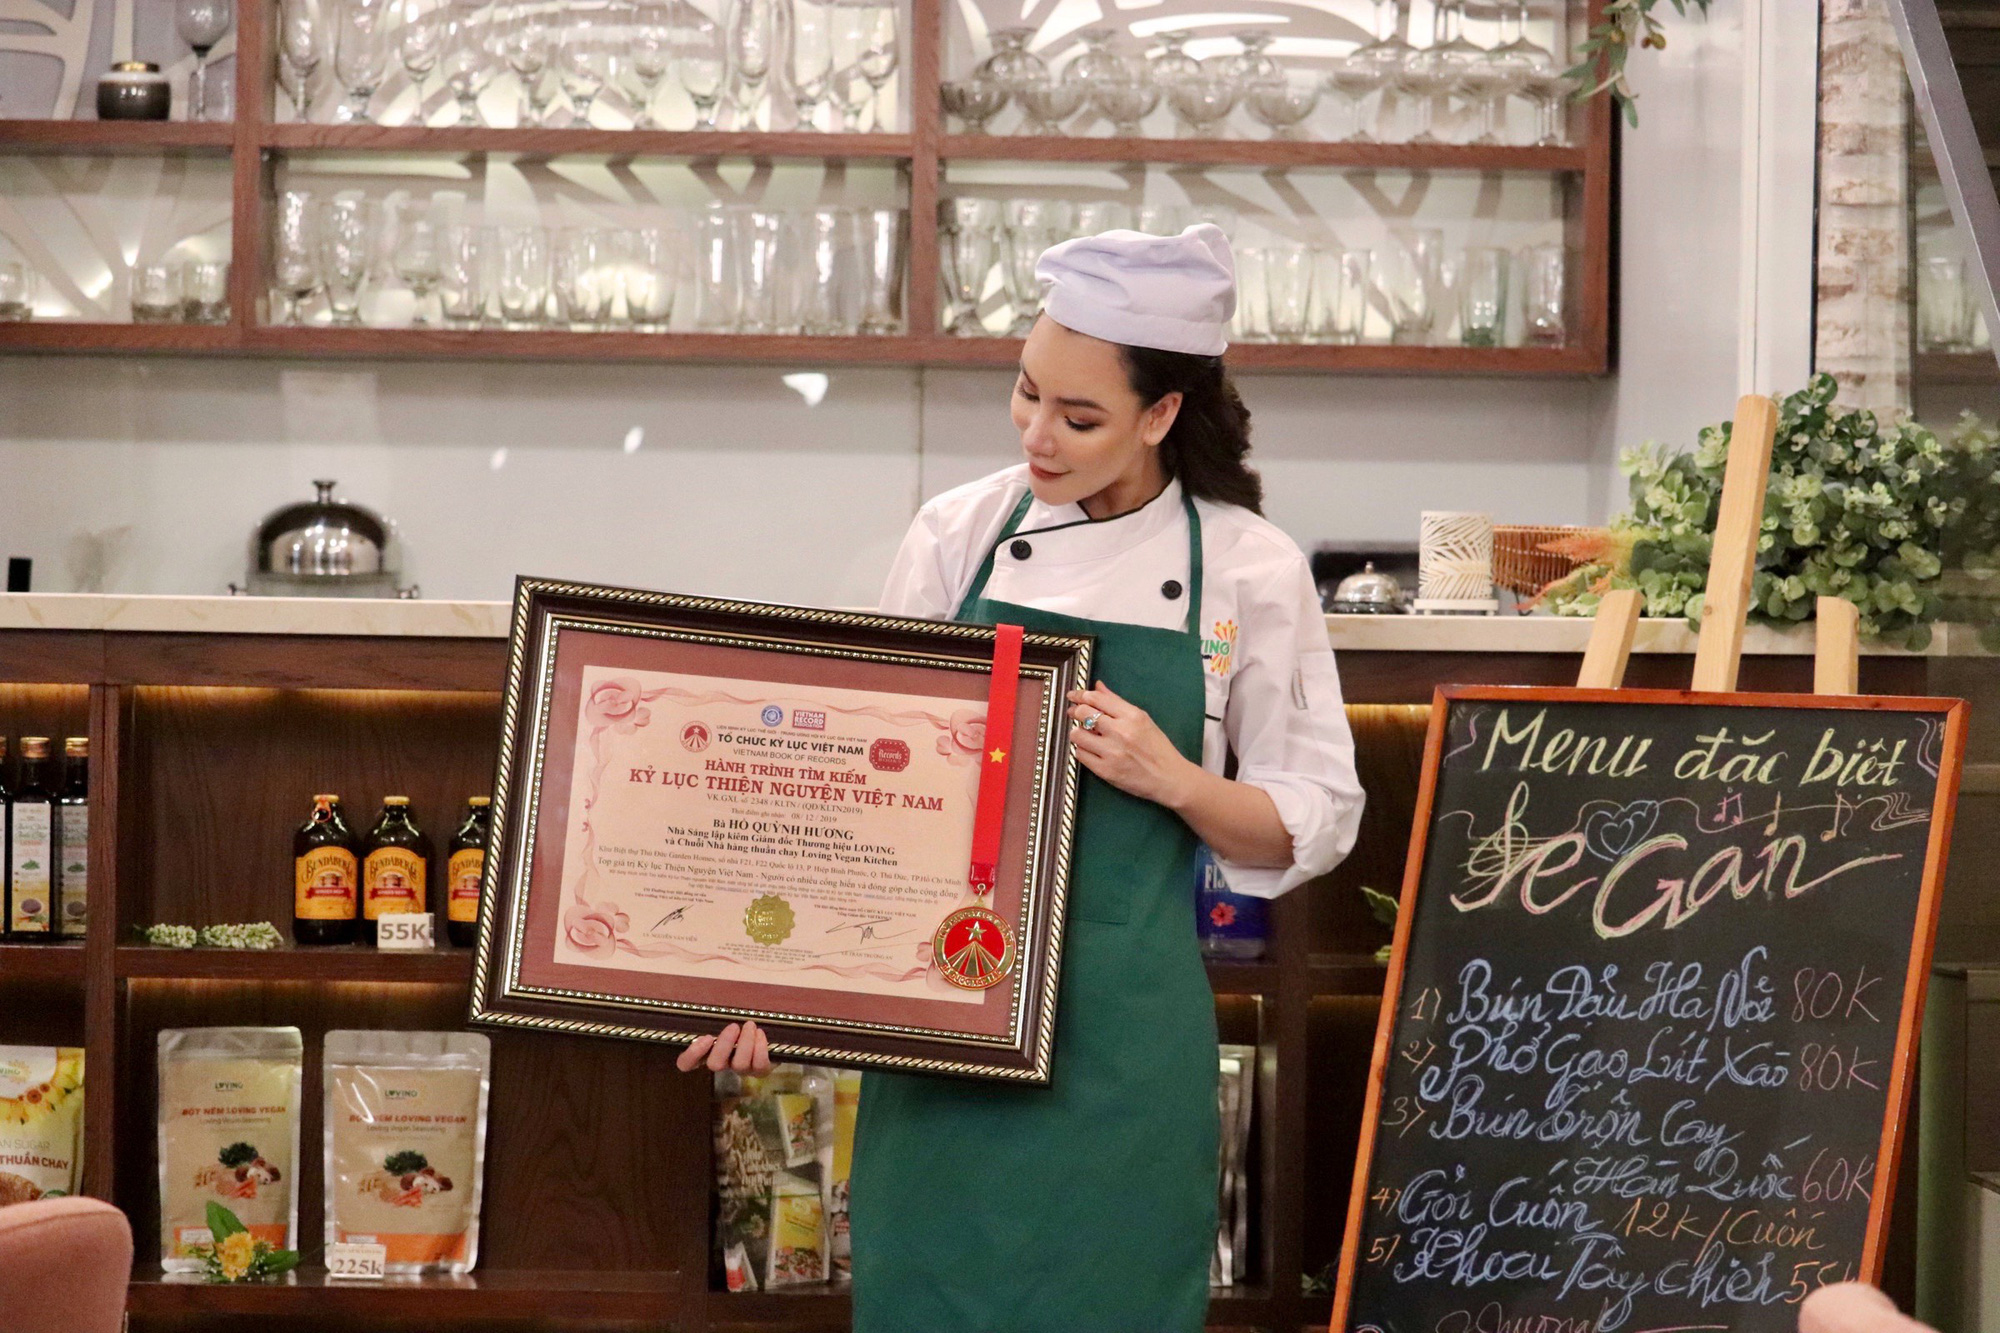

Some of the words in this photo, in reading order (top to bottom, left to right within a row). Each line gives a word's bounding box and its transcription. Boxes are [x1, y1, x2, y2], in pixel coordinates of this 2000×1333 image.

[794, 717, 824, 725] RECORD
[787, 740, 808, 751] LỤC
[811, 741, 835, 754] VIỆT
[837, 745, 864, 756] NAM
[1482, 708, 1652, 777] Menu
[733, 748, 769, 758] VIETNAM
[770, 752, 793, 761] BOOK
[807, 754, 847, 765] RECORDS
[705, 758, 746, 774] HÀNH
[750, 763, 794, 779] TRÌNH
[799, 768, 825, 781] TÌM
[829, 768, 867, 785] KIẾM
[629, 764, 656, 784] KỶ
[662, 772, 699, 790] LỤC
[705, 776, 764, 796] THIỆN
[769, 782, 846, 803] NGUYỆN
[852, 788, 896, 808] VIỆT
[902, 794, 943, 811] NAM
[750, 797, 769, 806] 2348
[774, 800, 796, 808] KLTN
[667, 826, 685, 835] Nhà
[687, 828, 709, 839] Sáng
[711, 830, 725, 841] lập
[727, 831, 749, 841] kiêm
[751, 834, 776, 844] Giám
[778, 835, 793, 845] đốc
[796, 838, 830, 850] Thương
[833, 841, 851, 852] hiệu
[854, 844, 895, 855] LOVING
[713, 819, 726, 828] Bà
[752, 821, 800, 835] QUỲNH
[804, 826, 854, 840] HƯƠNG
[677, 838, 704, 848] Chuỗi
[706, 840, 725, 850] Nhà
[727, 842, 749, 853] hàng
[751, 844, 776, 855] thuần
[778, 848, 798, 859] chay
[801, 850, 832, 861] Loving
[835, 853, 861, 863] Vegan
[864, 855, 898, 866] Kitchen
[598, 857, 612, 866] Top
[613, 858, 625, 867] giá
[626, 860, 635, 869] trị
[651, 862, 662, 870] lục
[664, 863, 686, 872] Thiện
[687, 865, 716, 876] Nguyện
[718, 868, 734, 877] Việt
[735, 870, 754, 879] Nam
[761, 872, 785, 882] Người
[786, 874, 795, 882] có
[797, 875, 818, 885] nhiều
[839, 878, 856, 888] hiến
[868, 883, 887, 892] đóng
[888, 885, 903, 894] góp
[904, 886, 918, 894] cho
[919, 888, 938, 898] cộng
[939, 889, 958, 899] đồng
[668, 852, 692, 860] Garden
[693, 854, 716, 863] Homes,
[769, 861, 785, 870] Quốc
[814, 865, 830, 874] Hiệp
[944, 878, 962, 886] Minh
[380, 923, 427, 941] 55K
[1446, 958, 1553, 1024] Bún
[1791, 966, 1883, 1023] 80K
[1799, 1042, 1880, 1091] 80K
[226, 1106, 257, 1115] LOVING
[259, 1105, 286, 1114] VEGAN
[395, 1114, 431, 1122] LOVING
[435, 1115, 467, 1123] VEGAN
[41, 1157, 69, 1170] CHAY
[1802, 1148, 1874, 1203] 60K
